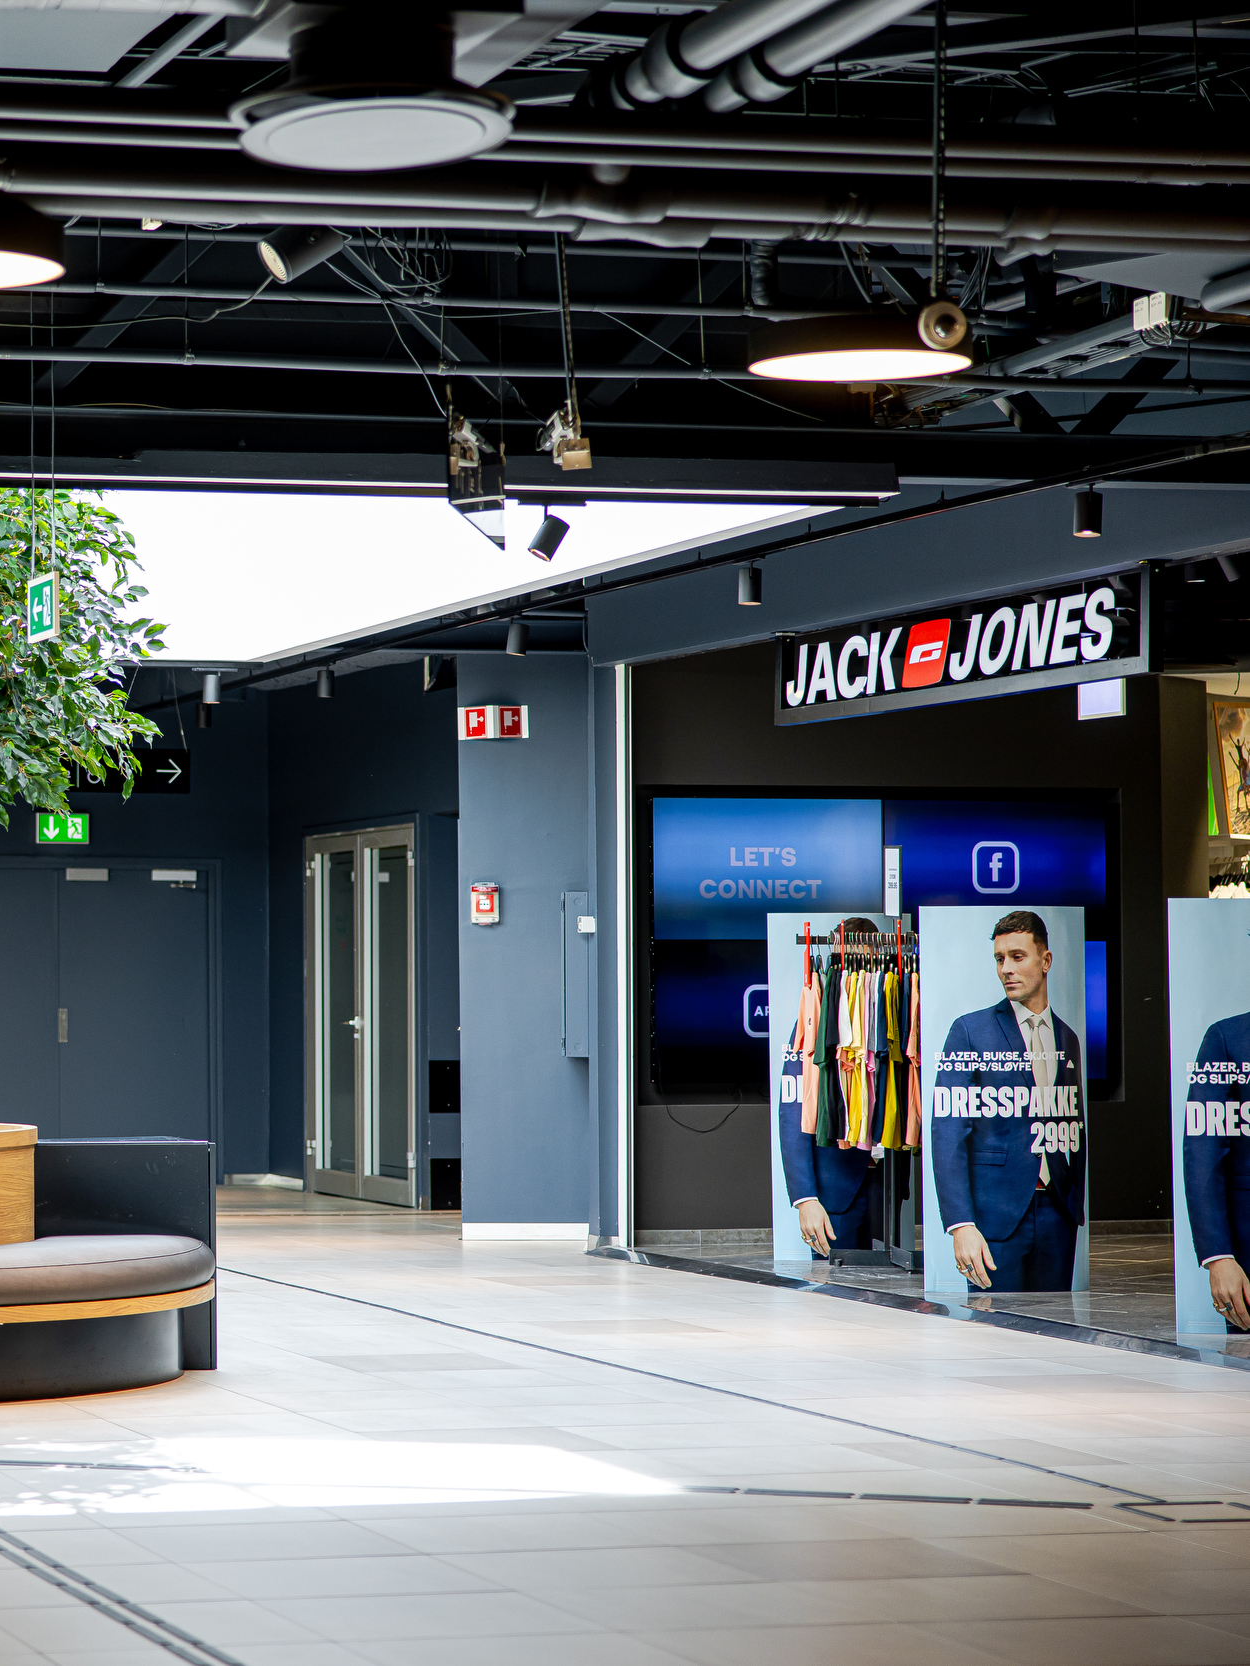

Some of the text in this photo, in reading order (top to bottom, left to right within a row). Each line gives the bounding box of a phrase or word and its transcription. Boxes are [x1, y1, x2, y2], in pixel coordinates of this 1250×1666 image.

[786, 587, 1116, 707] JACK JONES
[730, 847, 797, 867] LET'S
[699, 879, 822, 899] CONNECT
[934, 1051, 1066, 1062] BLAZER, BUKSE, SKJORTE
[934, 1062, 1032, 1072] OG SLIPS/SLØYFE
[1186, 1062, 1240, 1074] BLAZER,
[1186, 1074, 1208, 1084] OG
[934, 1086, 1078, 1118] DRESSPAKKE
